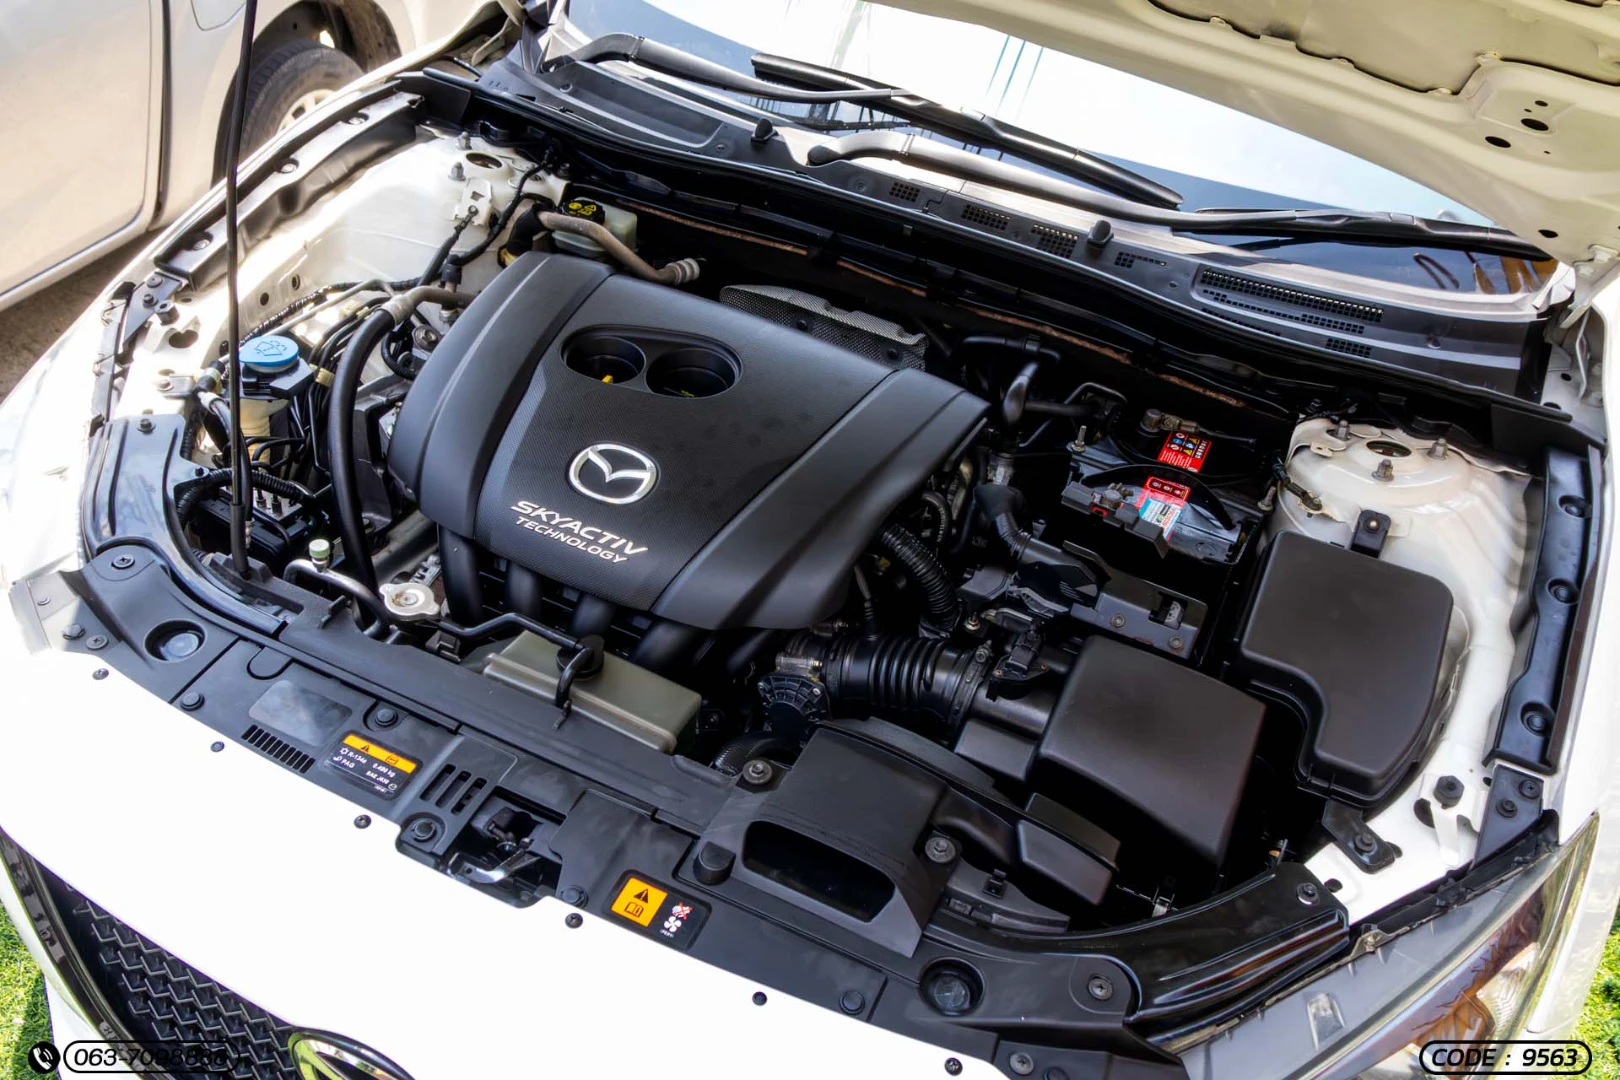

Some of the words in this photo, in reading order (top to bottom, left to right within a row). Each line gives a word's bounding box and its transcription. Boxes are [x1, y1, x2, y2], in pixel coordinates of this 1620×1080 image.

[510, 501, 648, 554] SKYACTIV
[515, 516, 627, 563] TECHNOLOGY
[347, 751, 367, 763] R-134a
[388, 768, 396, 778] kg
